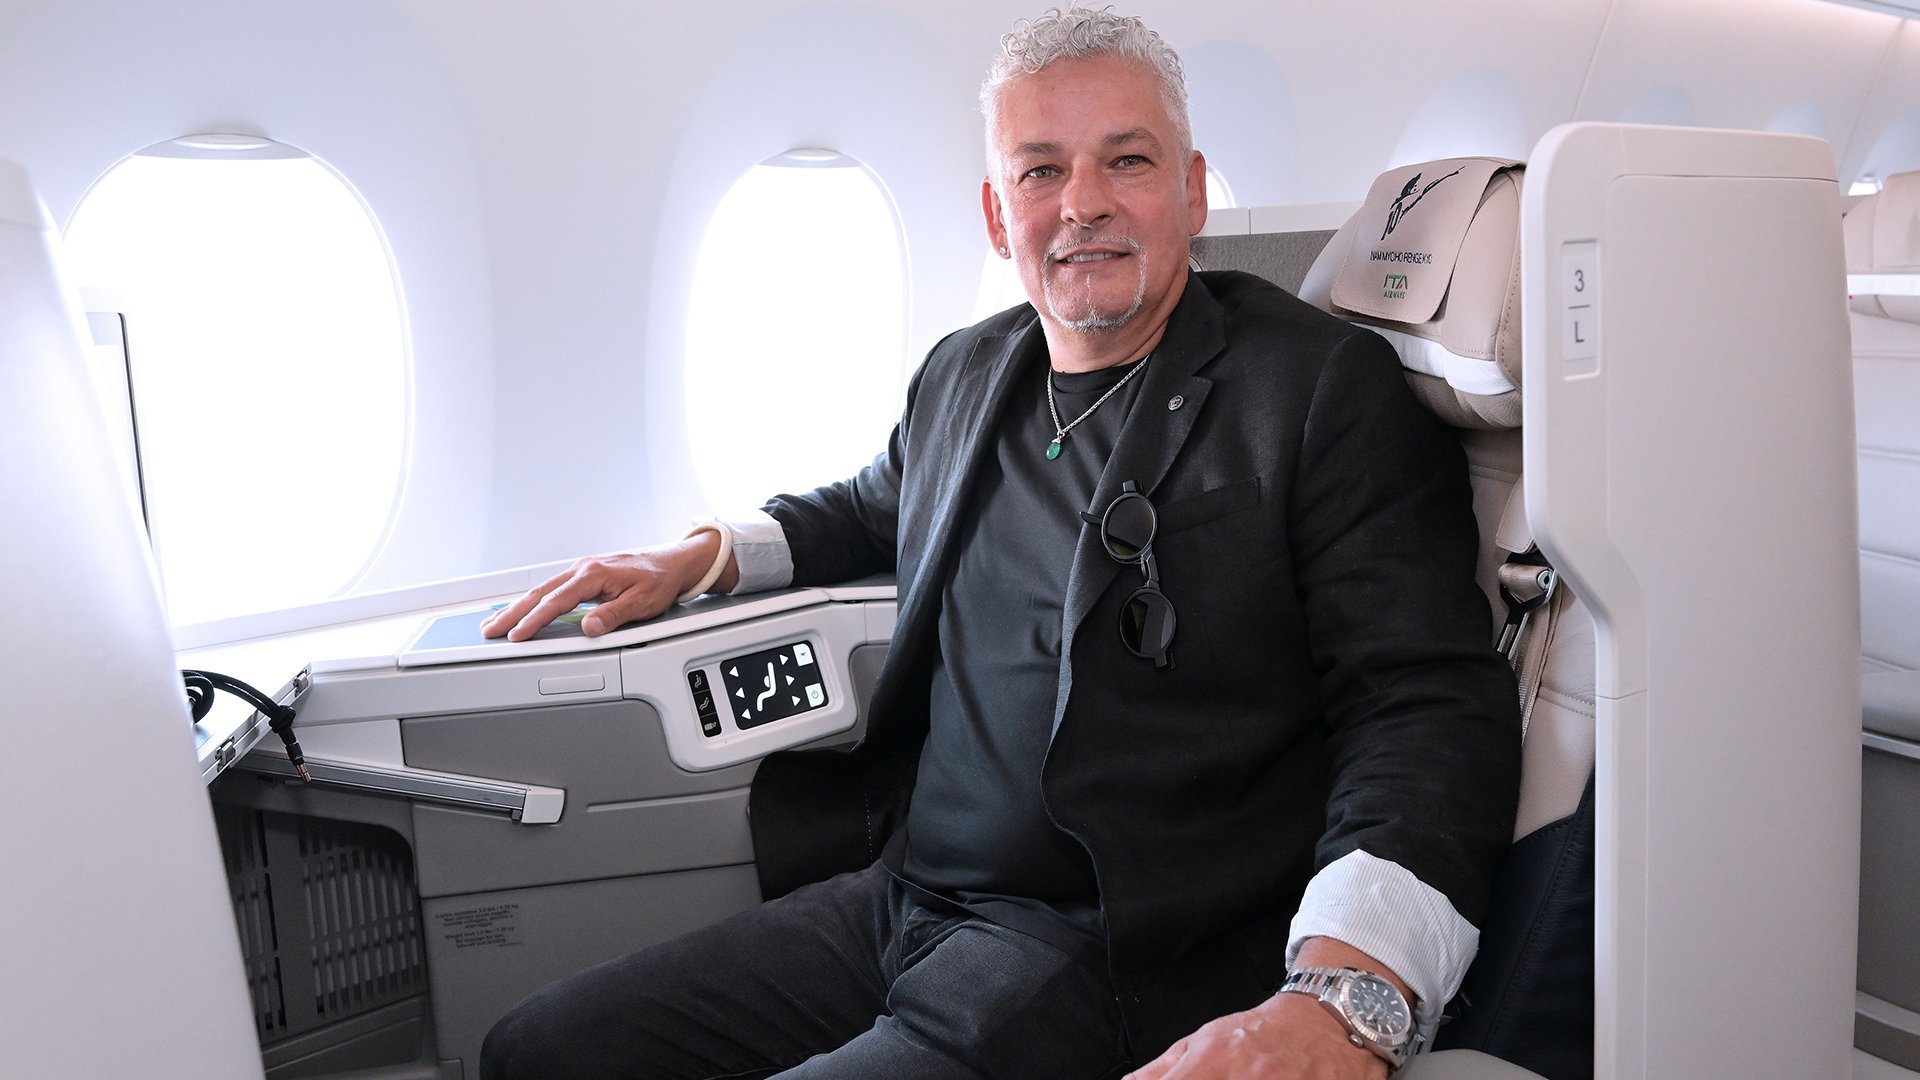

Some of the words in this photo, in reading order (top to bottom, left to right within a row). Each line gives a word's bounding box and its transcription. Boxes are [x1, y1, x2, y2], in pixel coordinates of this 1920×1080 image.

[1370, 251, 1382, 261] NAM
[1382, 251, 1403, 263] MYOHO
[1383, 274, 1408, 290] ITA
[1575, 269, 1585, 292] 3
[1383, 290, 1406, 300] AIRWAYS
[1575, 320, 1585, 343] L
